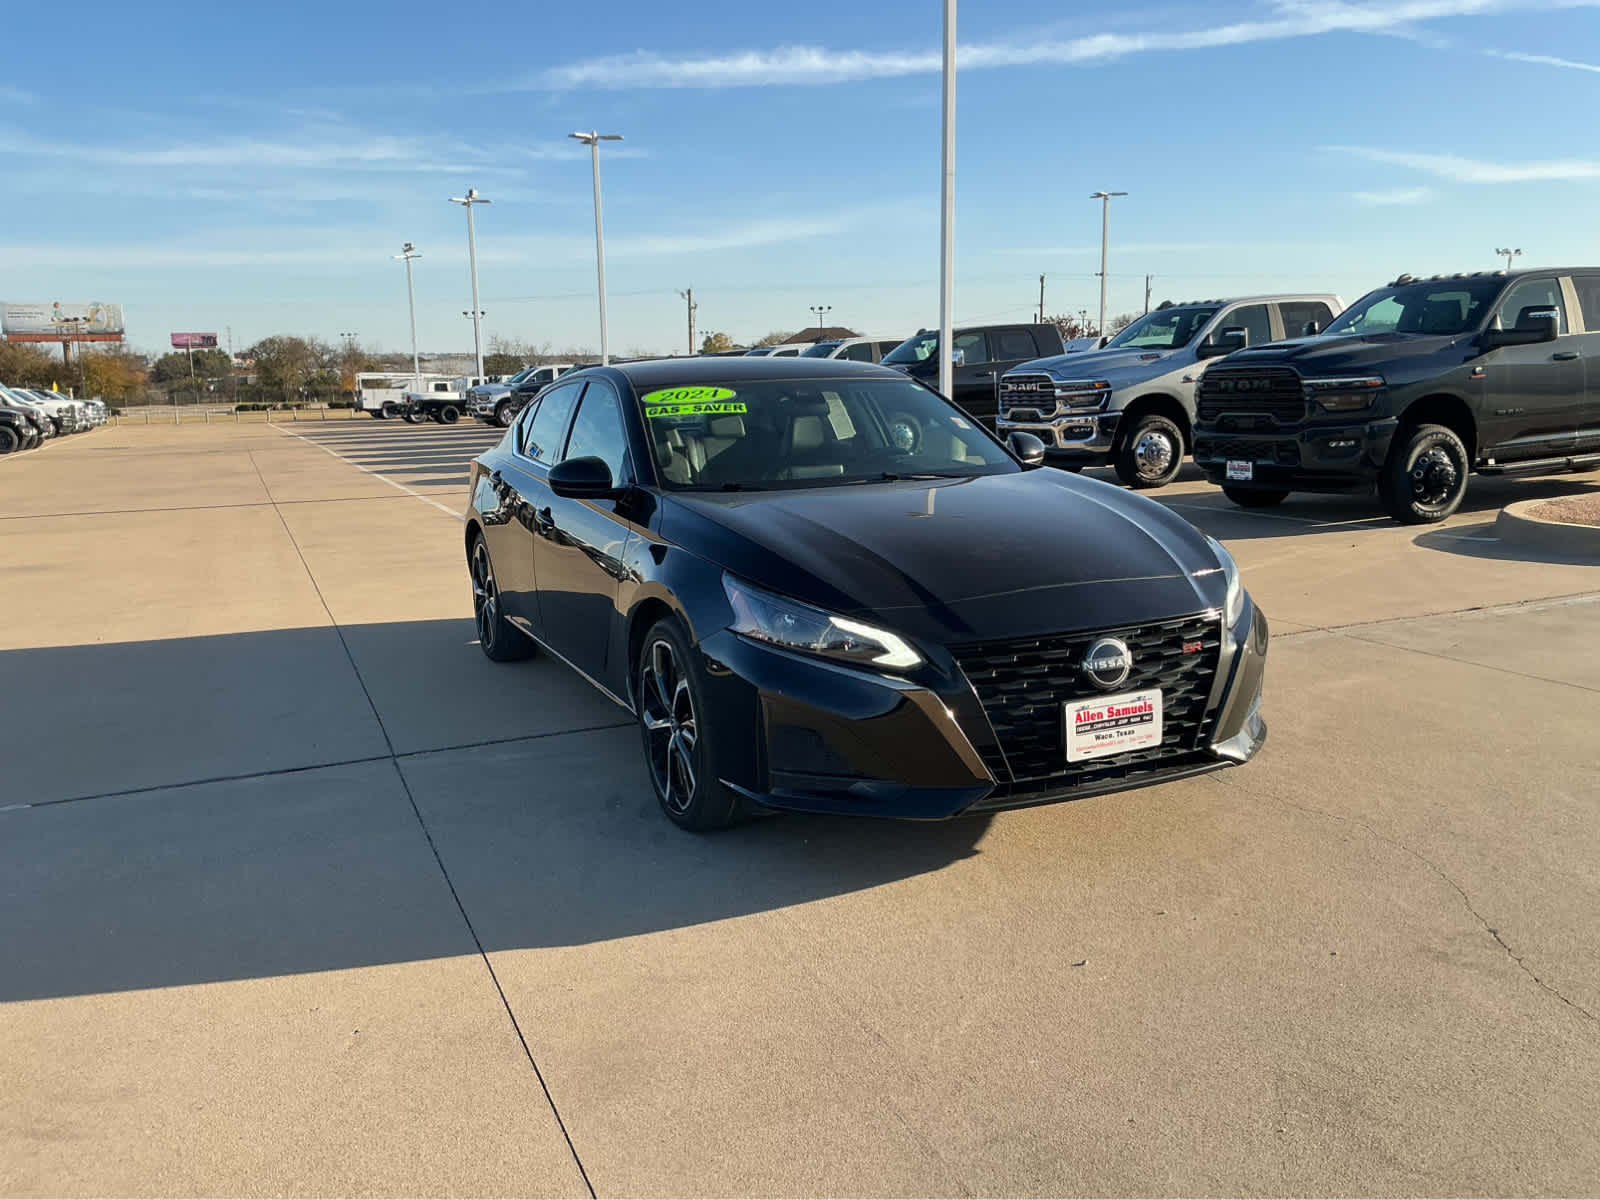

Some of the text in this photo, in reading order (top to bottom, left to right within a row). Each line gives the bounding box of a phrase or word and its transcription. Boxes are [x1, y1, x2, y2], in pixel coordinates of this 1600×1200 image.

[1009, 383, 1037, 392] RAM
[659, 388, 719, 402] 2024
[1082, 650, 1132, 672] NISSAN
[1075, 701, 1153, 724] Allen Samuels
[1094, 729, 1135, 742] Waco, Texas
